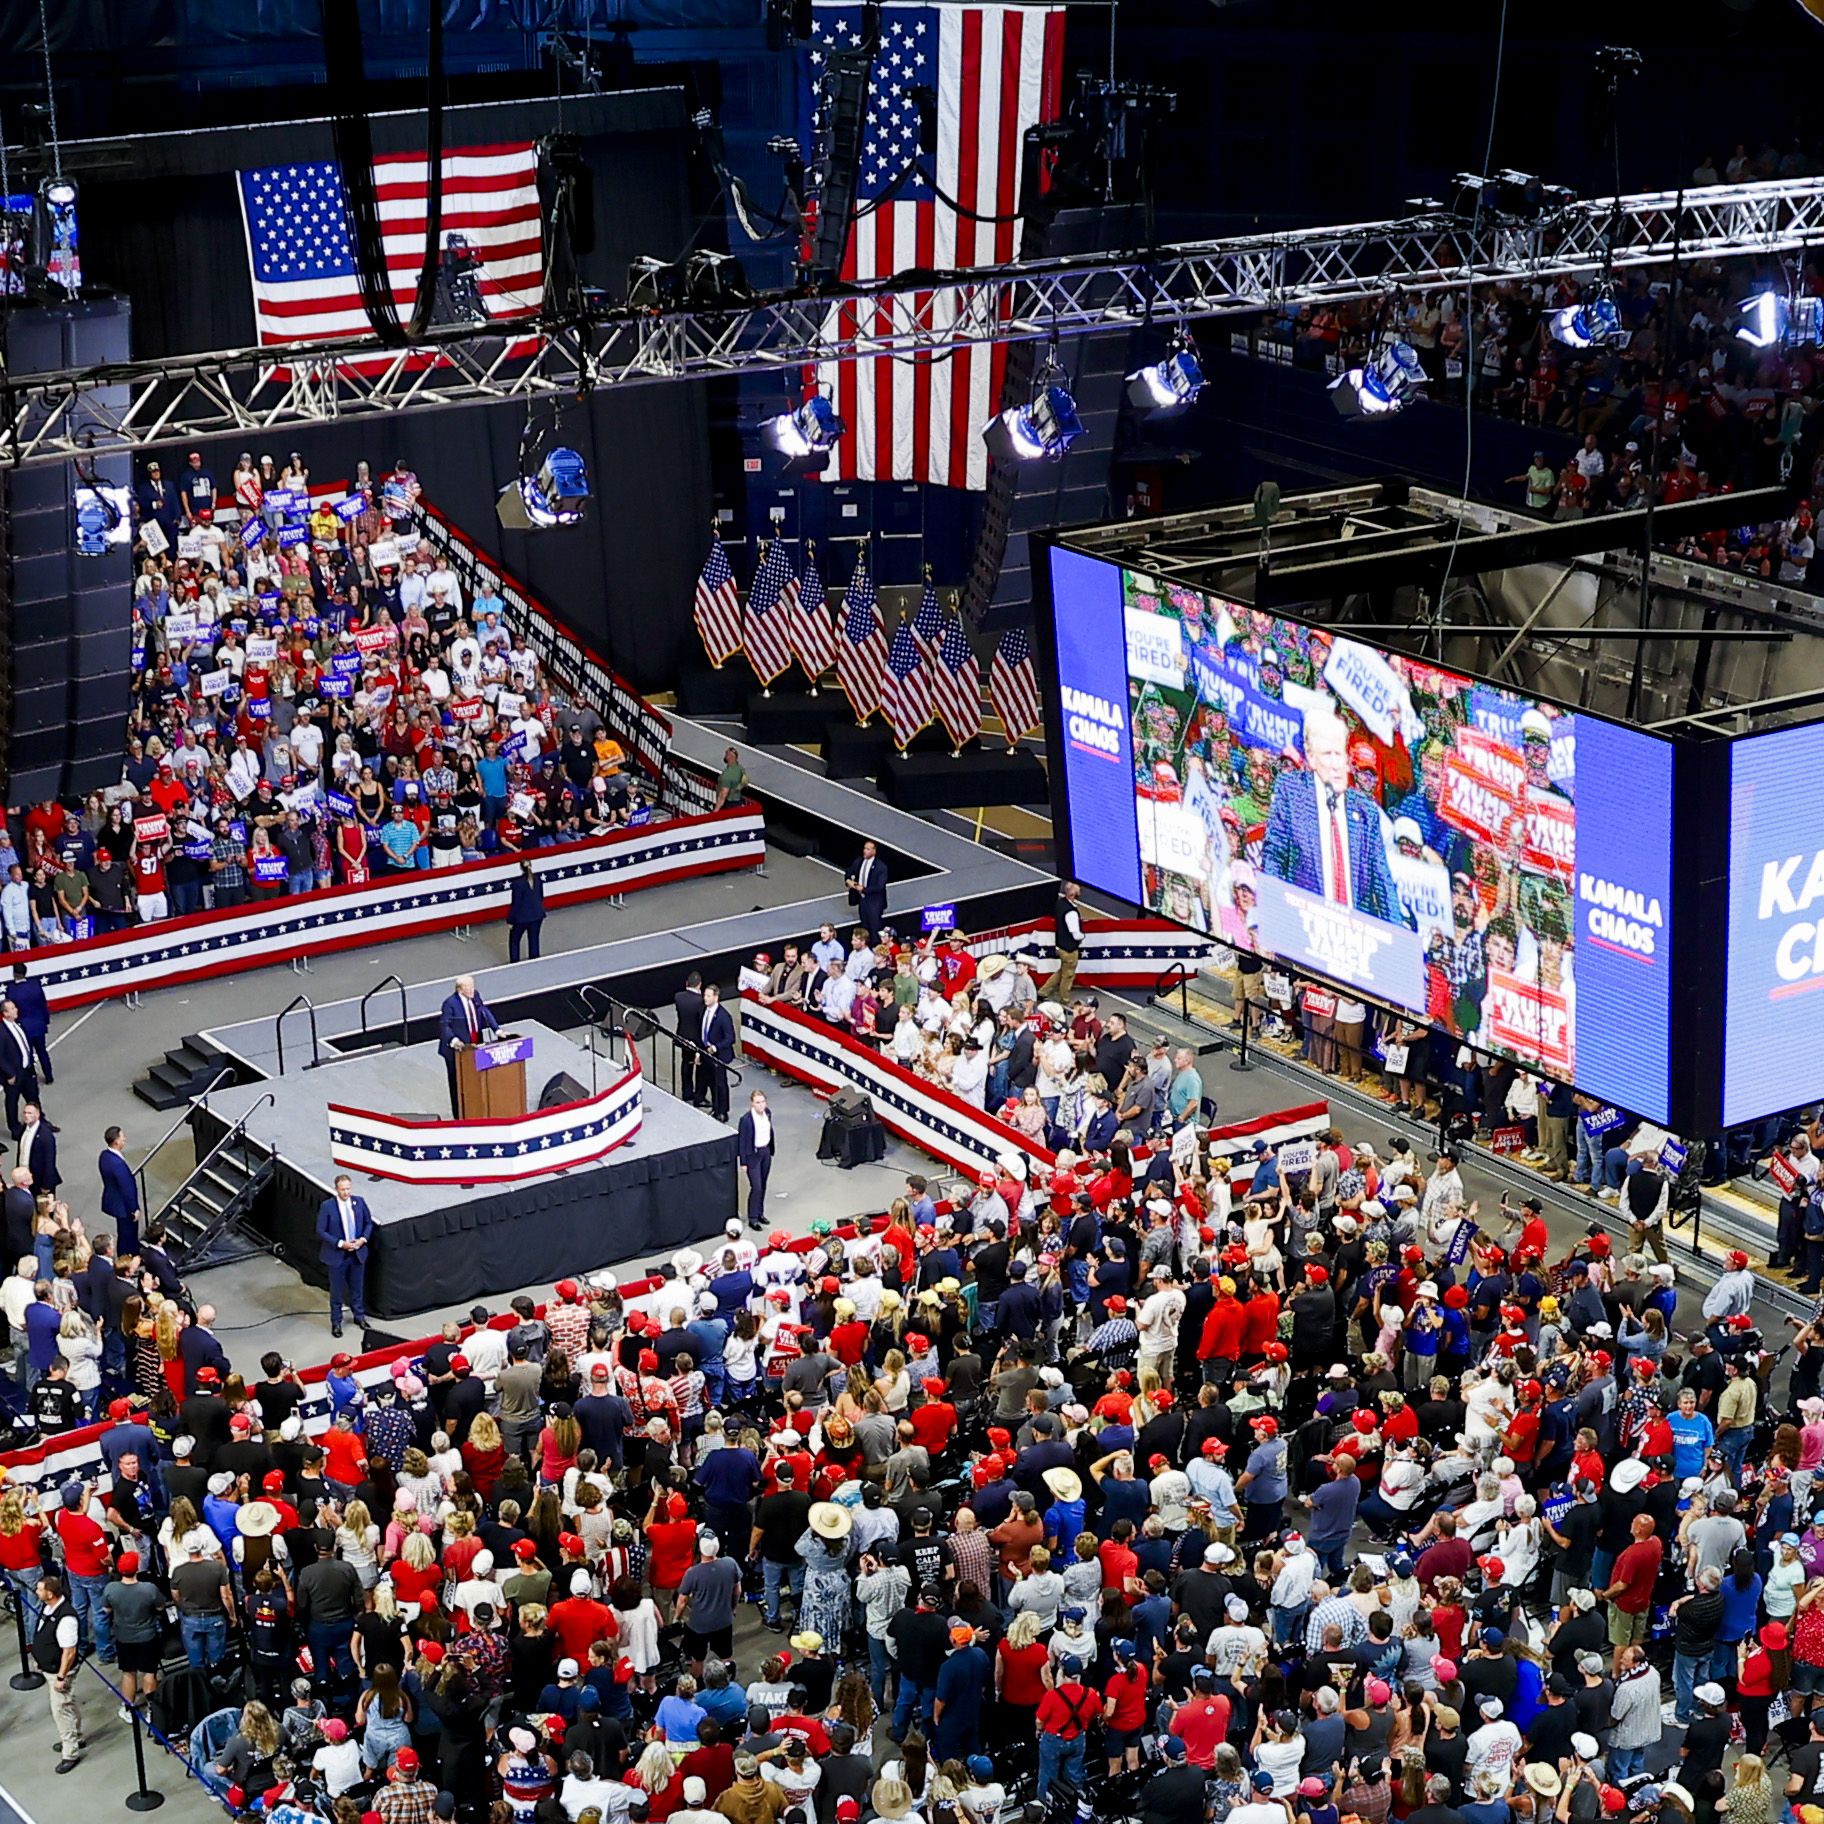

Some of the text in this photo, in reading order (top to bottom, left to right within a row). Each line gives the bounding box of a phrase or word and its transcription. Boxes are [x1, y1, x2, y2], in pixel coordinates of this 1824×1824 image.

[1127, 629, 1171, 650] YOU'RE
[1346, 649, 1392, 700] YOU'RE
[1336, 659, 1393, 720] FIRED!
[1061, 685, 1124, 730] KAMALA
[1069, 717, 1120, 754] CHAOS
[1446, 767, 1511, 820] TRUMP
[141, 856, 156, 874] 97
[1397, 877, 1438, 899] OU'RE
[1580, 872, 1663, 927] KAMALA
[1587, 906, 1655, 954] CHAOS
[1489, 984, 1569, 1036] TRUMP
[1496, 1008, 1565, 1058] VANCE
[1584, 1108, 1616, 1122] TRUMP
[1280, 1155, 1311, 1166] FIRED!
[1281, 1149, 1309, 1159] YOU'RE
[1673, 1436, 1698, 1444] TRUMP
[915, 1546, 938, 1556] KEEP
[916, 1555, 940, 1564] CALM
